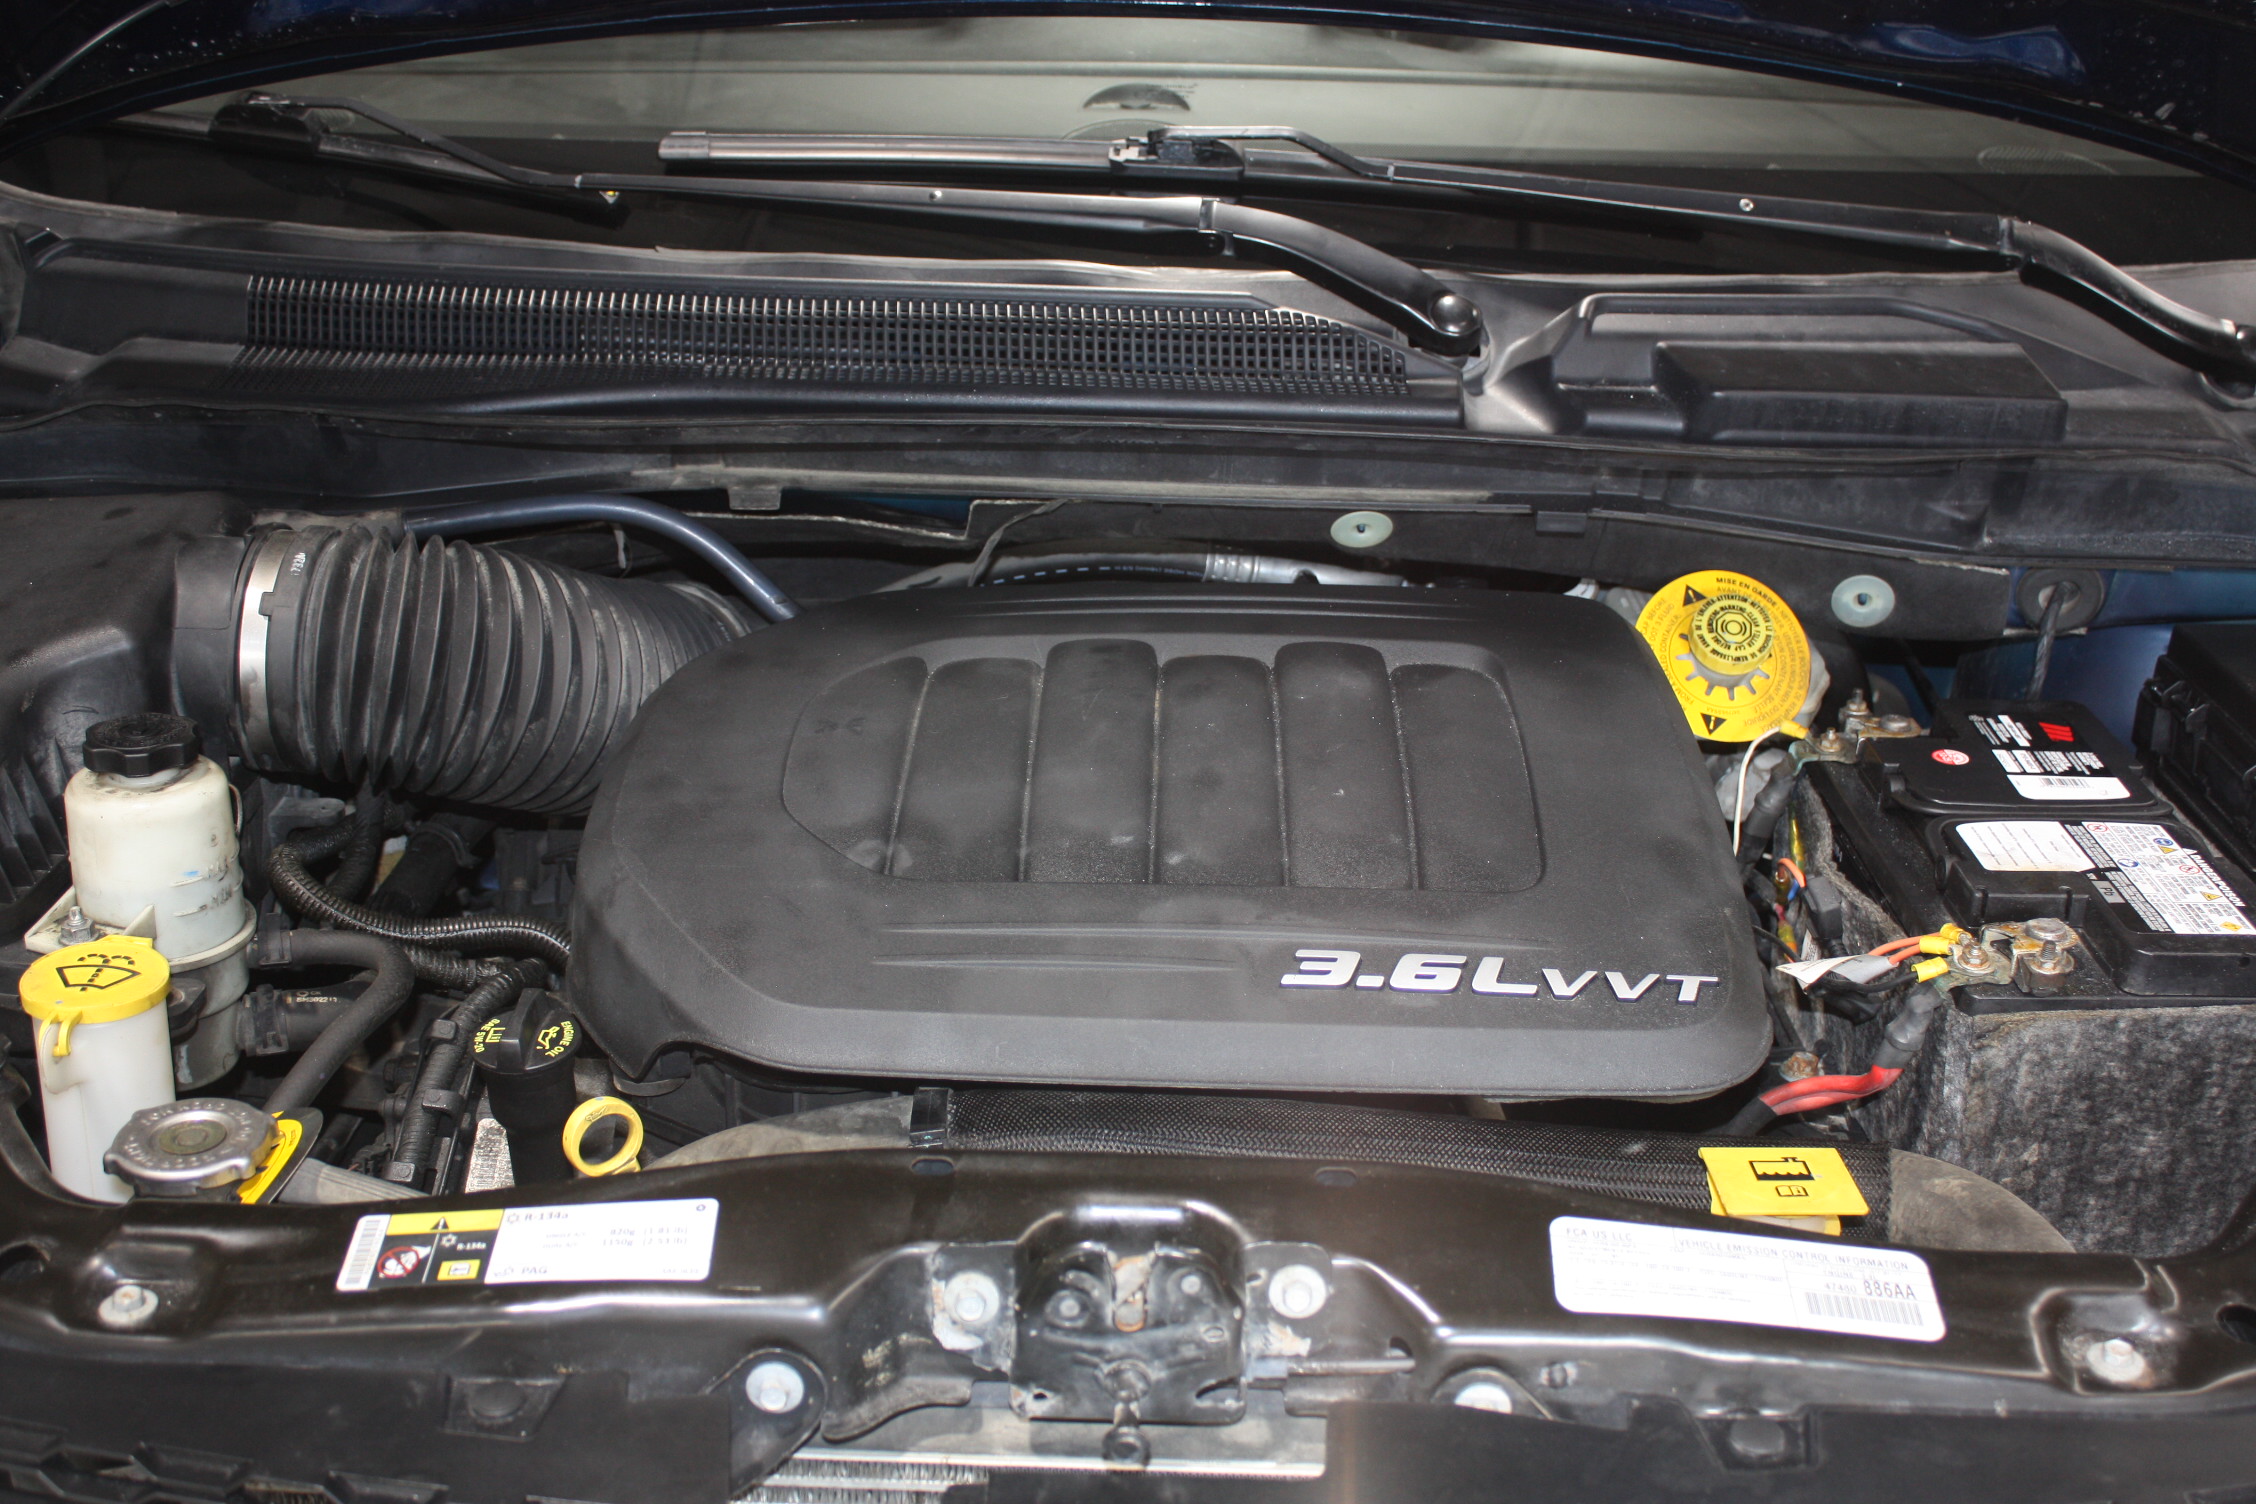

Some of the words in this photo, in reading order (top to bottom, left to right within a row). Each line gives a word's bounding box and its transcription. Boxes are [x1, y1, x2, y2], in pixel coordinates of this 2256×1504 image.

[1716, 577, 1738, 585] MISE
[1739, 581, 1750, 590] EN
[1752, 586, 1777, 608] GARDE
[480, 1018, 501, 1031] SAE
[560, 1020, 575, 1046] ENGINE
[473, 1031, 486, 1053] 5W-20
[544, 1046, 565, 1058] OIL
[524, 1210, 569, 1222] R-134a
[1566, 1227, 1588, 1237] FCA
[1592, 1230, 1608, 1239] US
[1612, 1232, 1632, 1242] LLC
[1678, 1239, 1723, 1252] VEHICLE
[1726, 1243, 1778, 1257] EMISSION
[1782, 1249, 1831, 1264] CONTROL
[1835, 1255, 1909, 1270] INFORMATION
[1863, 1279, 1917, 1300] 886AA
